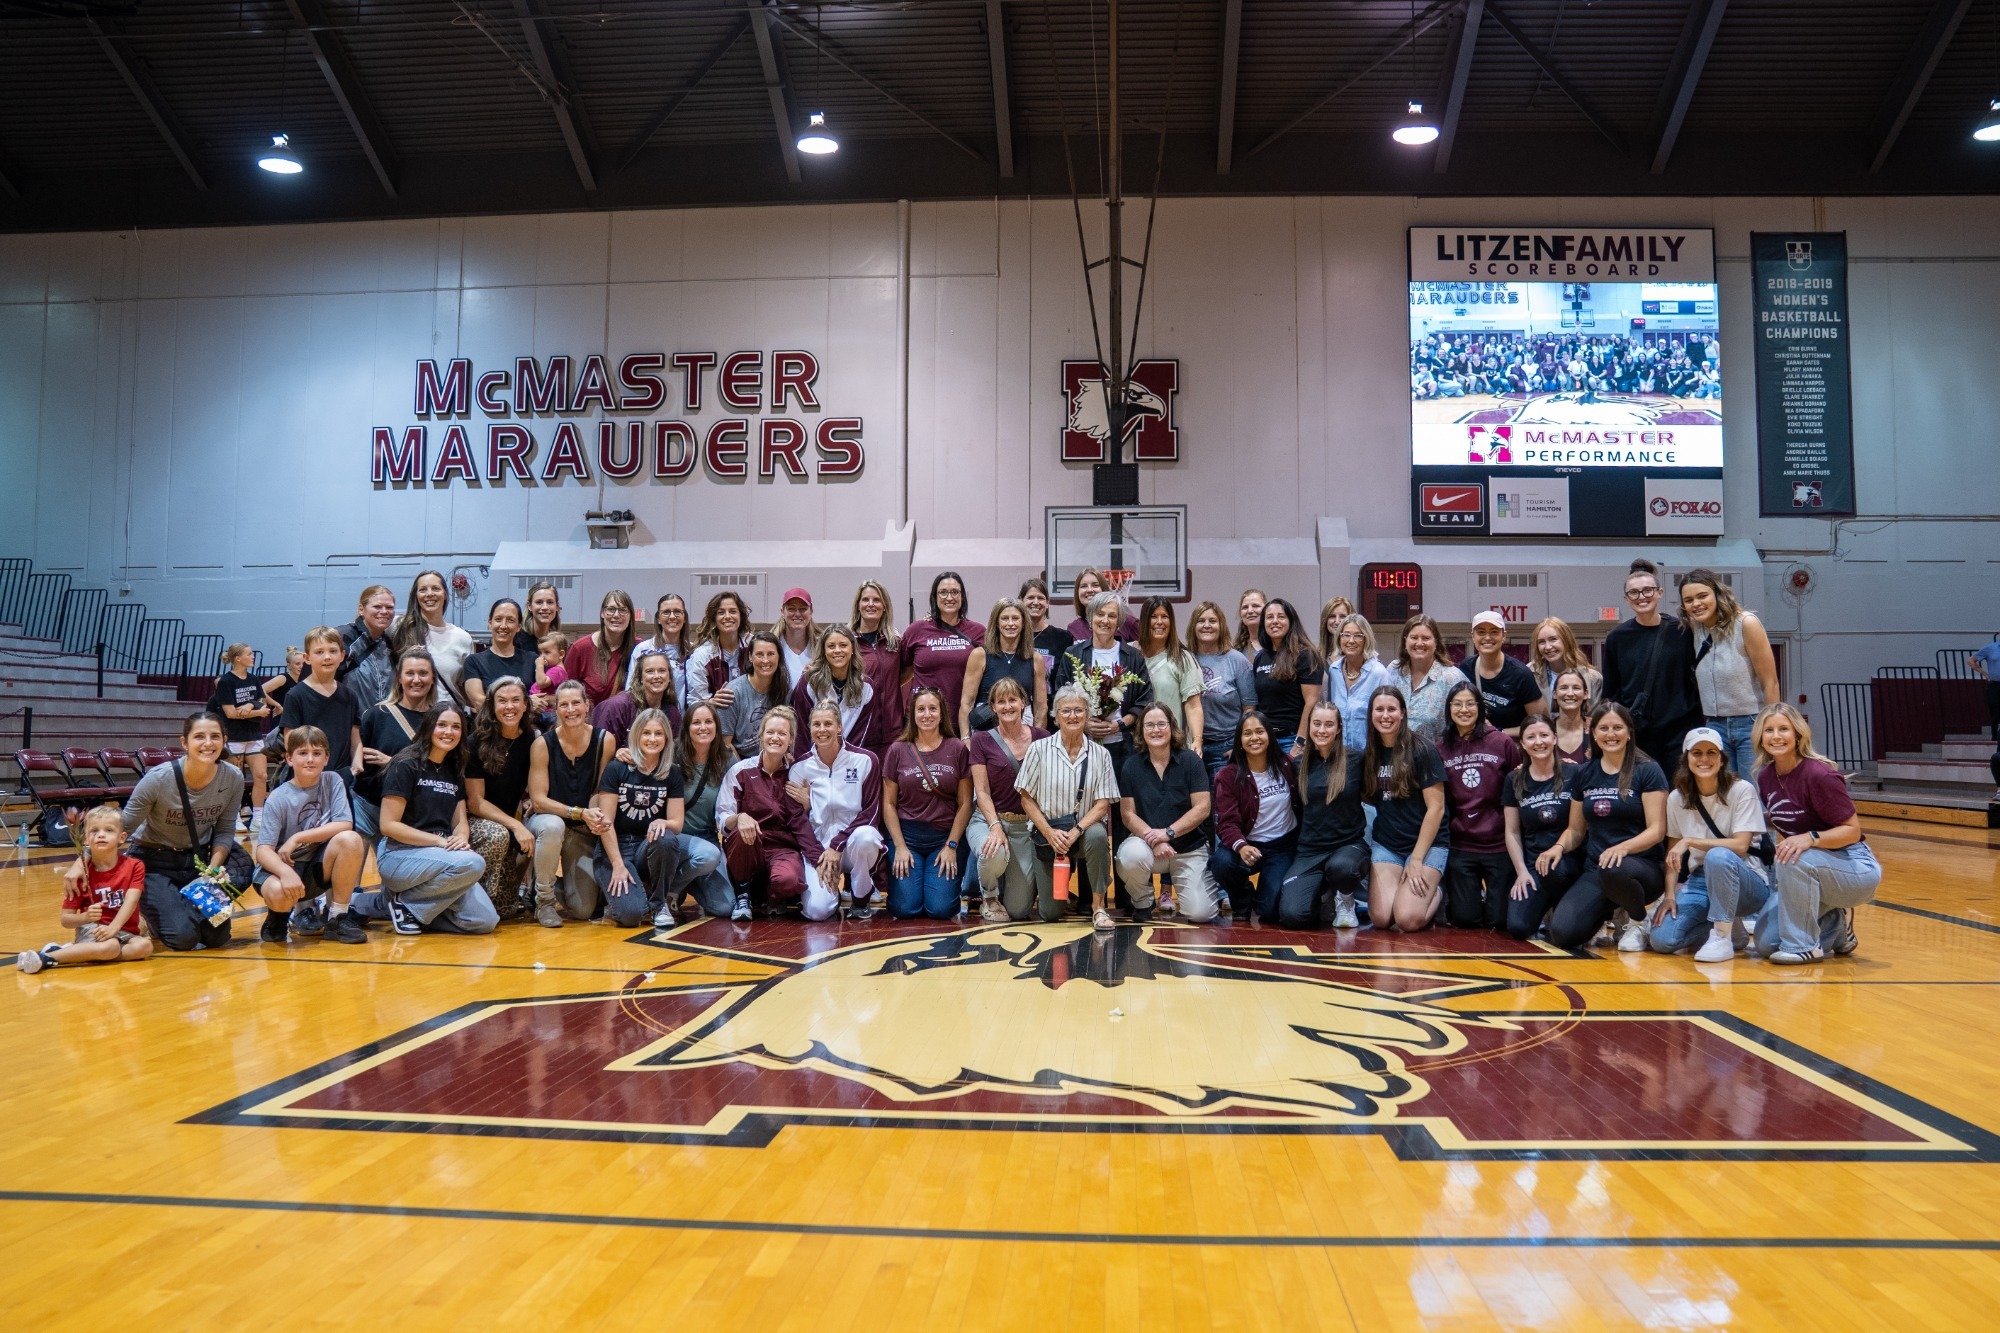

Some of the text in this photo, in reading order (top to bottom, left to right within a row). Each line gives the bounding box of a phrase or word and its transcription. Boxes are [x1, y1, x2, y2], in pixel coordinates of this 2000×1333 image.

[1468, 264, 1660, 276] SCOREBOARD
[1768, 278, 1832, 289] 2018-2019
[1773, 295, 1828, 306] WOMEN'S
[1762, 312, 1842, 322] BASKETBALL
[1766, 328, 1838, 339] CHAMPIONS
[414, 349, 821, 416] McMASTER
[1524, 430, 1676, 445] McMASTER
[370, 417, 864, 484] MARAUDERS
[1526, 450, 1676, 463] PERFORMANCE
[1374, 570, 1417, 588] 10:00
[926, 638, 970, 646] MARAUDERS
[1583, 788, 1634, 797] McMASTR
[618, 787, 667, 820] CHAMPIONS
[1530, 800, 1561, 808] BASKETBALL
